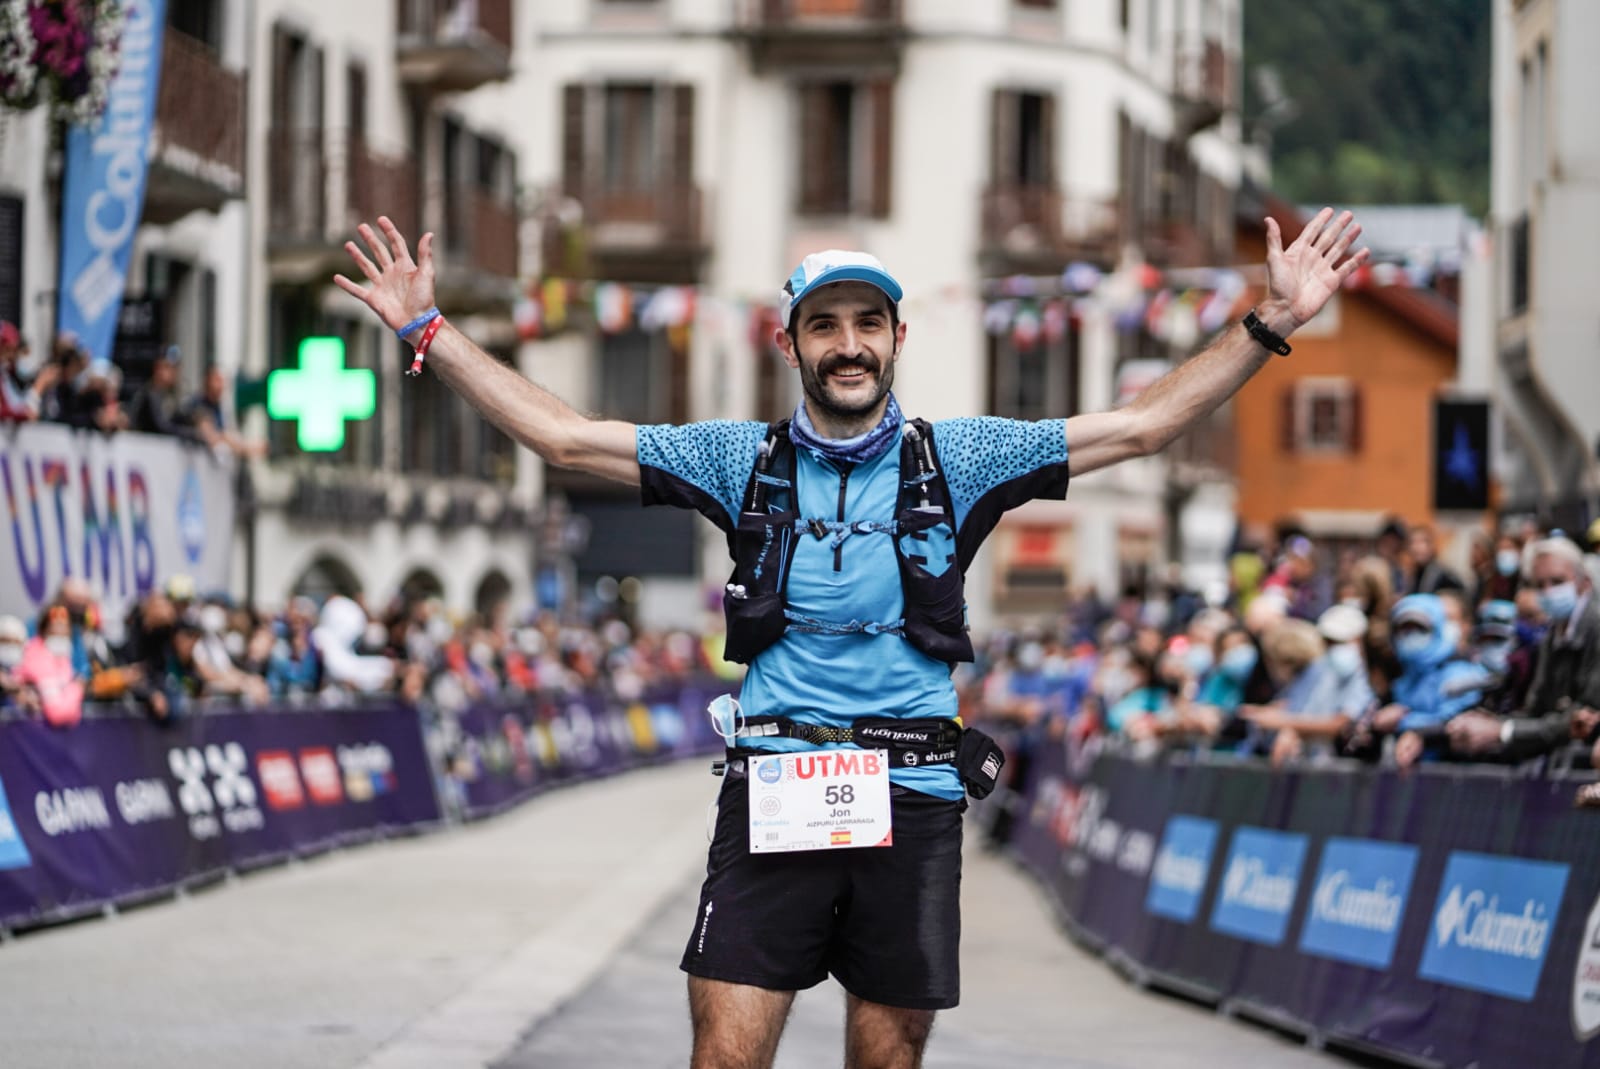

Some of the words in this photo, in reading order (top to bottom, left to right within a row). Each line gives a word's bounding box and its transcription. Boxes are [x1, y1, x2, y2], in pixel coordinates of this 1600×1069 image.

[0, 454, 158, 605] UTMB
[862, 728, 928, 741] RaidLight
[786, 759, 796, 780] 2021
[795, 754, 880, 779] UTMB
[825, 784, 855, 805] 58
[829, 808, 851, 818] Jon
[807, 820, 834, 828] AIZPURU
[1456, 888, 1549, 961] Columbia
